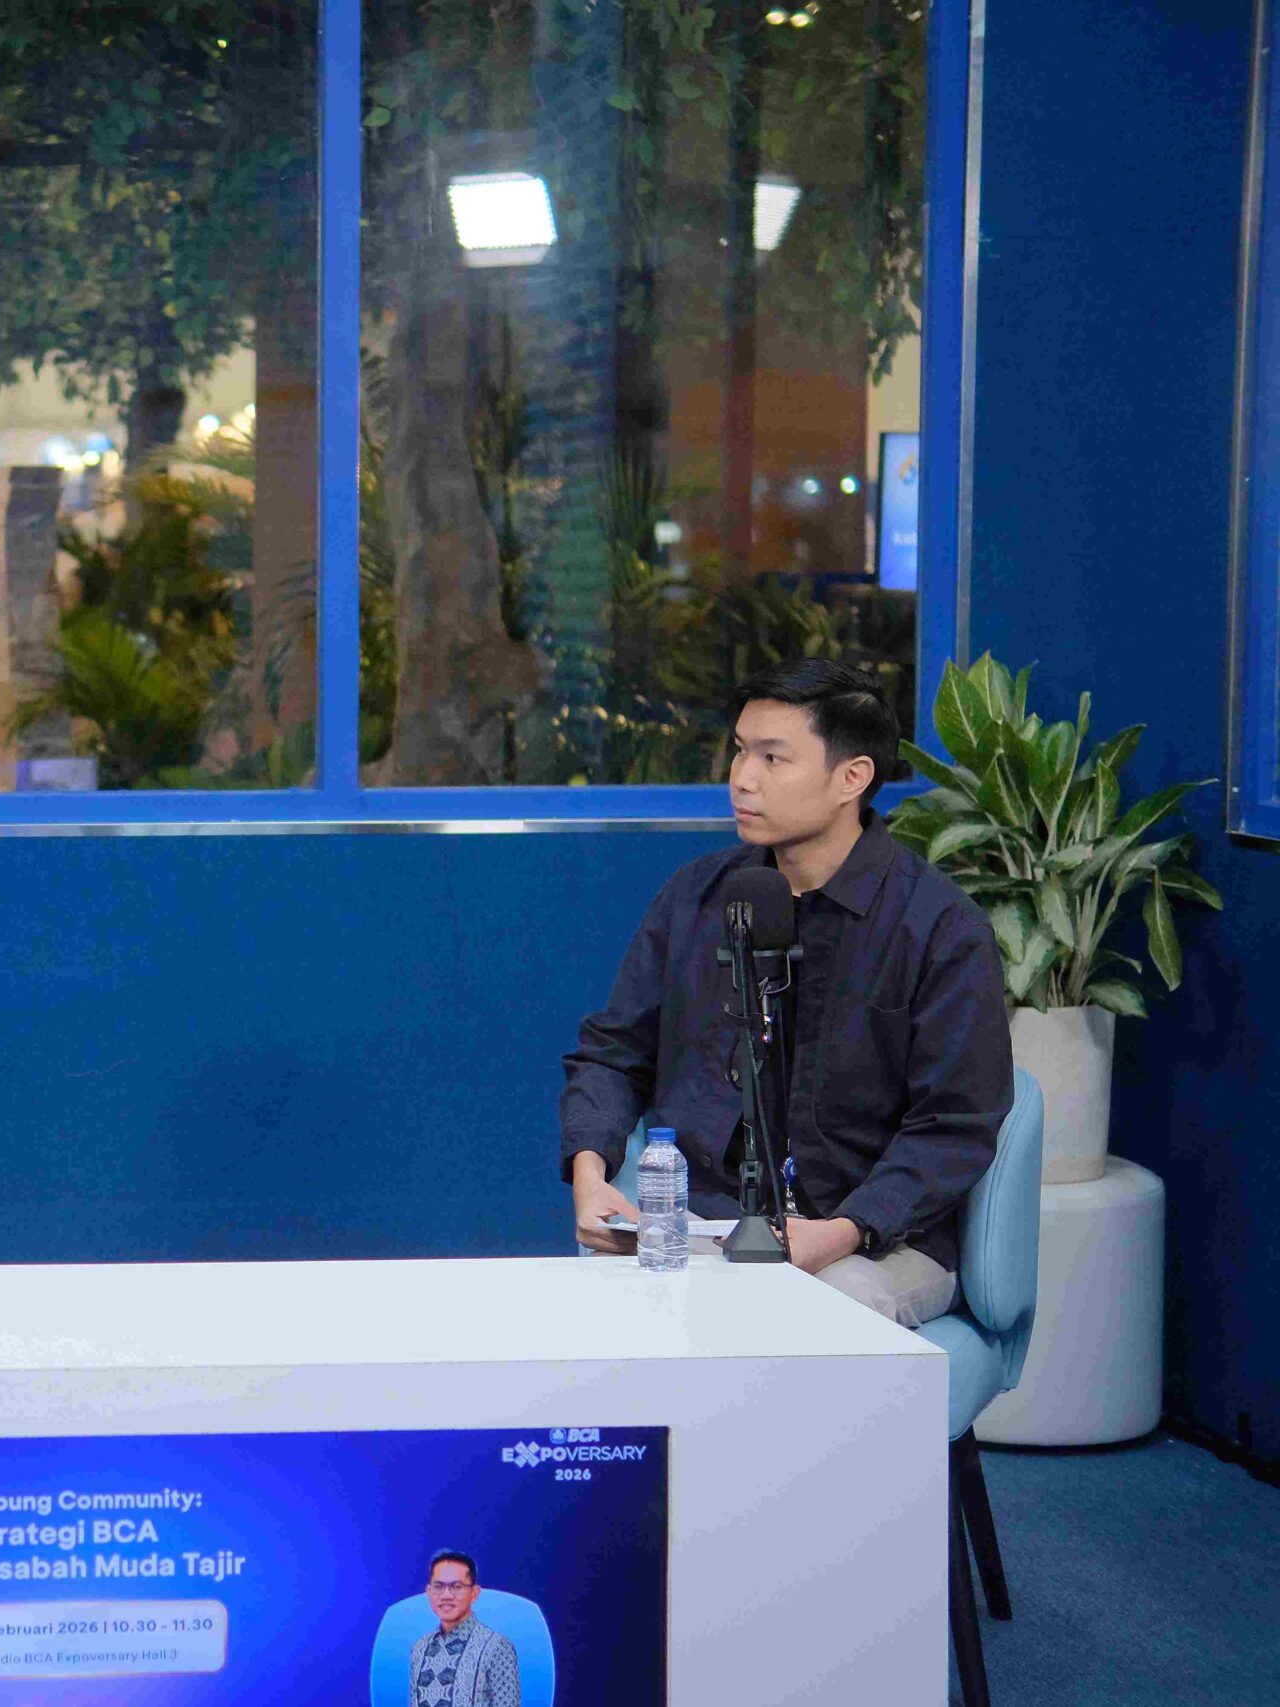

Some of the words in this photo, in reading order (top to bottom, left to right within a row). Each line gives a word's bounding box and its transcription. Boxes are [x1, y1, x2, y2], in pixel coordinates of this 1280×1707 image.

[568, 1429, 600, 1442] BCA
[502, 1441, 646, 1468] EXPOVERSARY
[555, 1469, 591, 1480] 2026
[58, 1488, 202, 1512] Community:
[93, 1519, 159, 1543] BCA
[95, 1553, 175, 1578] Muda
[182, 1551, 246, 1582] Tajir
[58, 1621, 98, 1634] 2026
[112, 1620, 157, 1633] 10.30
[173, 1618, 213, 1631] 11.30
[25, 1652, 53, 1664] BCA
[57, 1650, 138, 1664] Expoversary
[142, 1649, 167, 1660] Hall
[170, 1649, 178, 1660] 3
